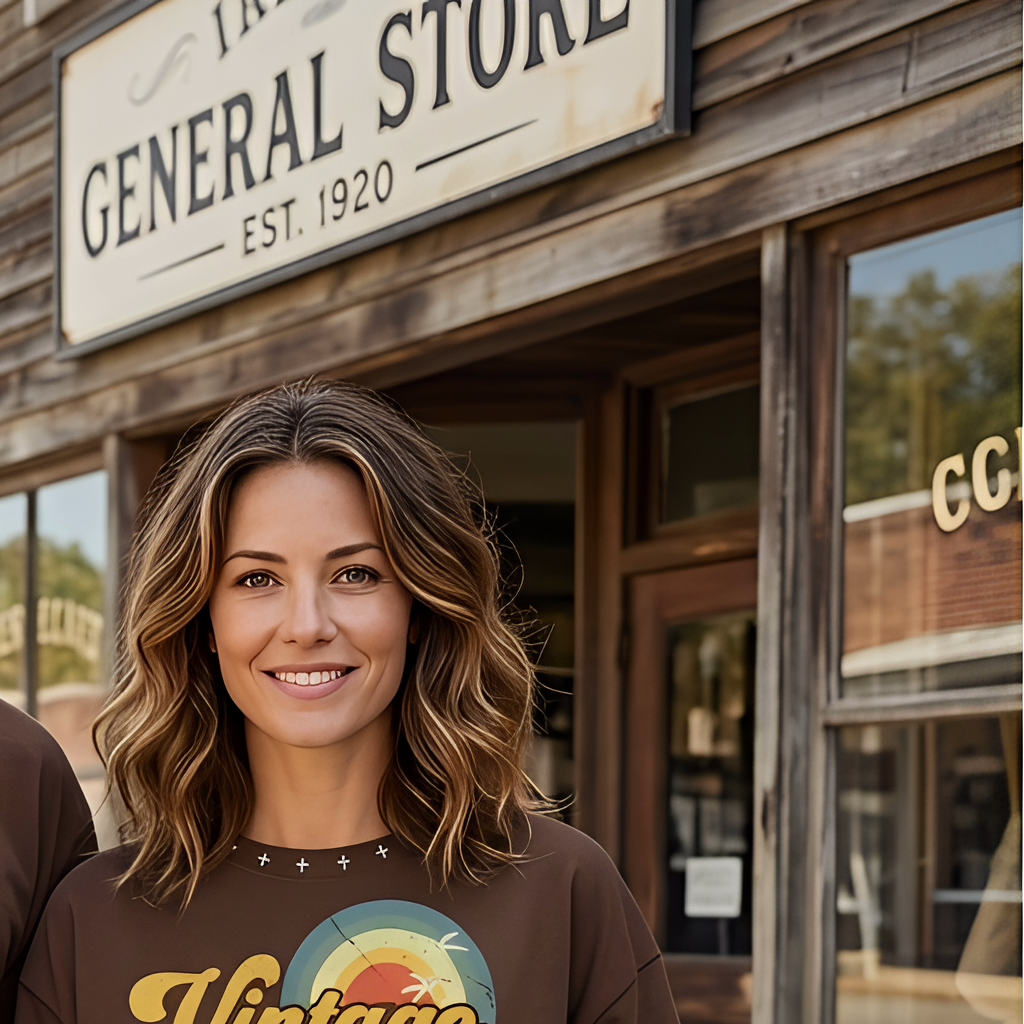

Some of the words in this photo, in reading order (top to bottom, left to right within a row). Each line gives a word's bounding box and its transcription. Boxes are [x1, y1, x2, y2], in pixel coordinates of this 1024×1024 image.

[81, 50, 344, 258] GENERAL
[242, 200, 304, 256] EST.
[318, 160, 394, 229] 1920
